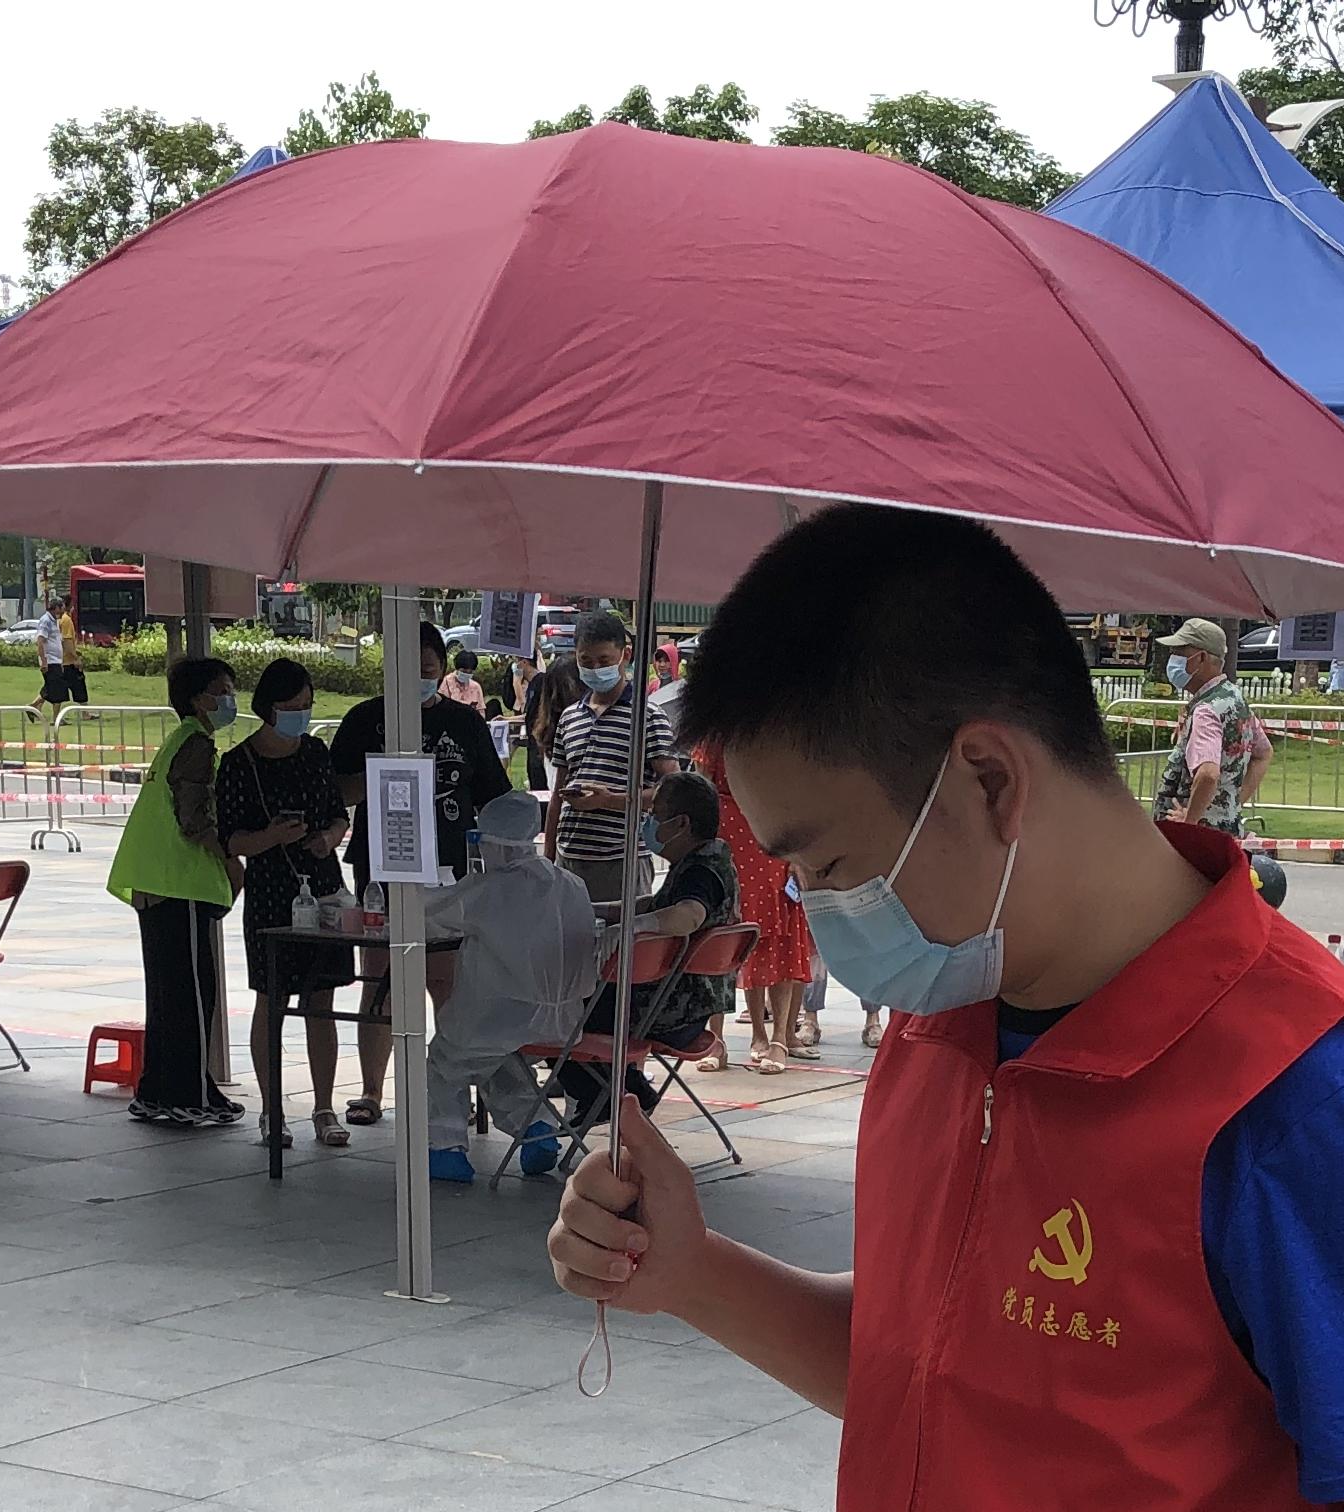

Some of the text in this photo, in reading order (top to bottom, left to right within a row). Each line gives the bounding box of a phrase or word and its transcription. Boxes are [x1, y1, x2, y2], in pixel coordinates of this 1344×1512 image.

[1001, 1287, 1121, 1348] 党员志愿者
